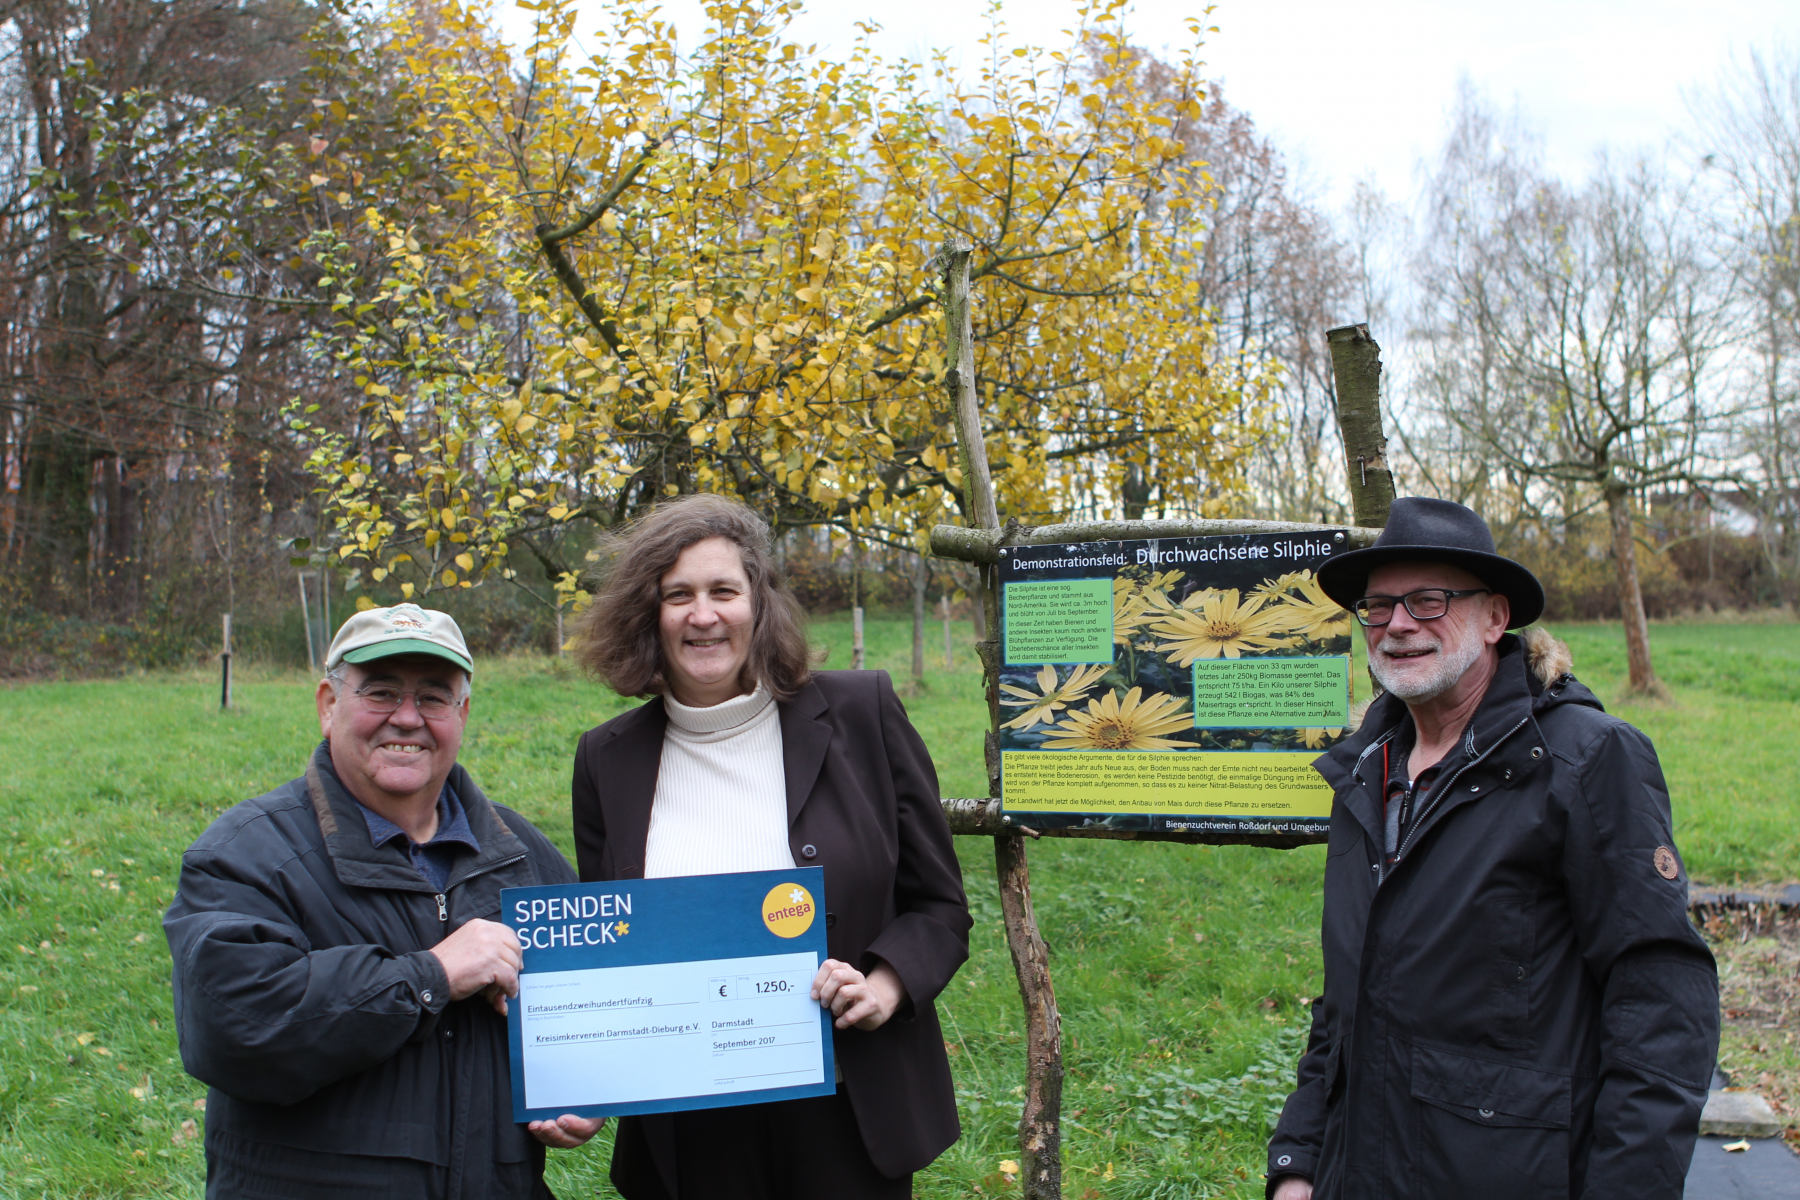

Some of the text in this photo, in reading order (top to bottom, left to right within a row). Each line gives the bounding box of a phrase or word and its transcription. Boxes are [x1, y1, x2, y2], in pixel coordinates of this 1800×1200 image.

[1013, 540, 1331, 570] Demonstrationsfeld: Durchwachsene Silphie
[1019, 585, 1038, 594] Silphie
[1009, 593, 1047, 602] Becherpflanze
[1068, 608, 1100, 616] September.
[1210, 782, 1262, 790] Nitrat-Belastung
[1081, 799, 1117, 807] Möglichkeit,
[1166, 821, 1236, 829] Bienenzuchtverein
[1239, 822, 1271, 830] Roßdorf
[1291, 823, 1330, 832] Umgebun
[515, 893, 632, 923] SPENDEN
[768, 903, 811, 922] entega
[517, 922, 616, 950] SCHECK
[719, 985, 727, 997] €
[756, 980, 794, 993] 1.250,-
[528, 997, 653, 1013] Eintausendzweihundertfünfzig
[712, 1018, 754, 1028] Darmstadt
[536, 1031, 604, 1042] Kreisimkerverein
[607, 1025, 683, 1037] Darmstadt-Dieburg
[713, 1037, 775, 1050] September 2017
